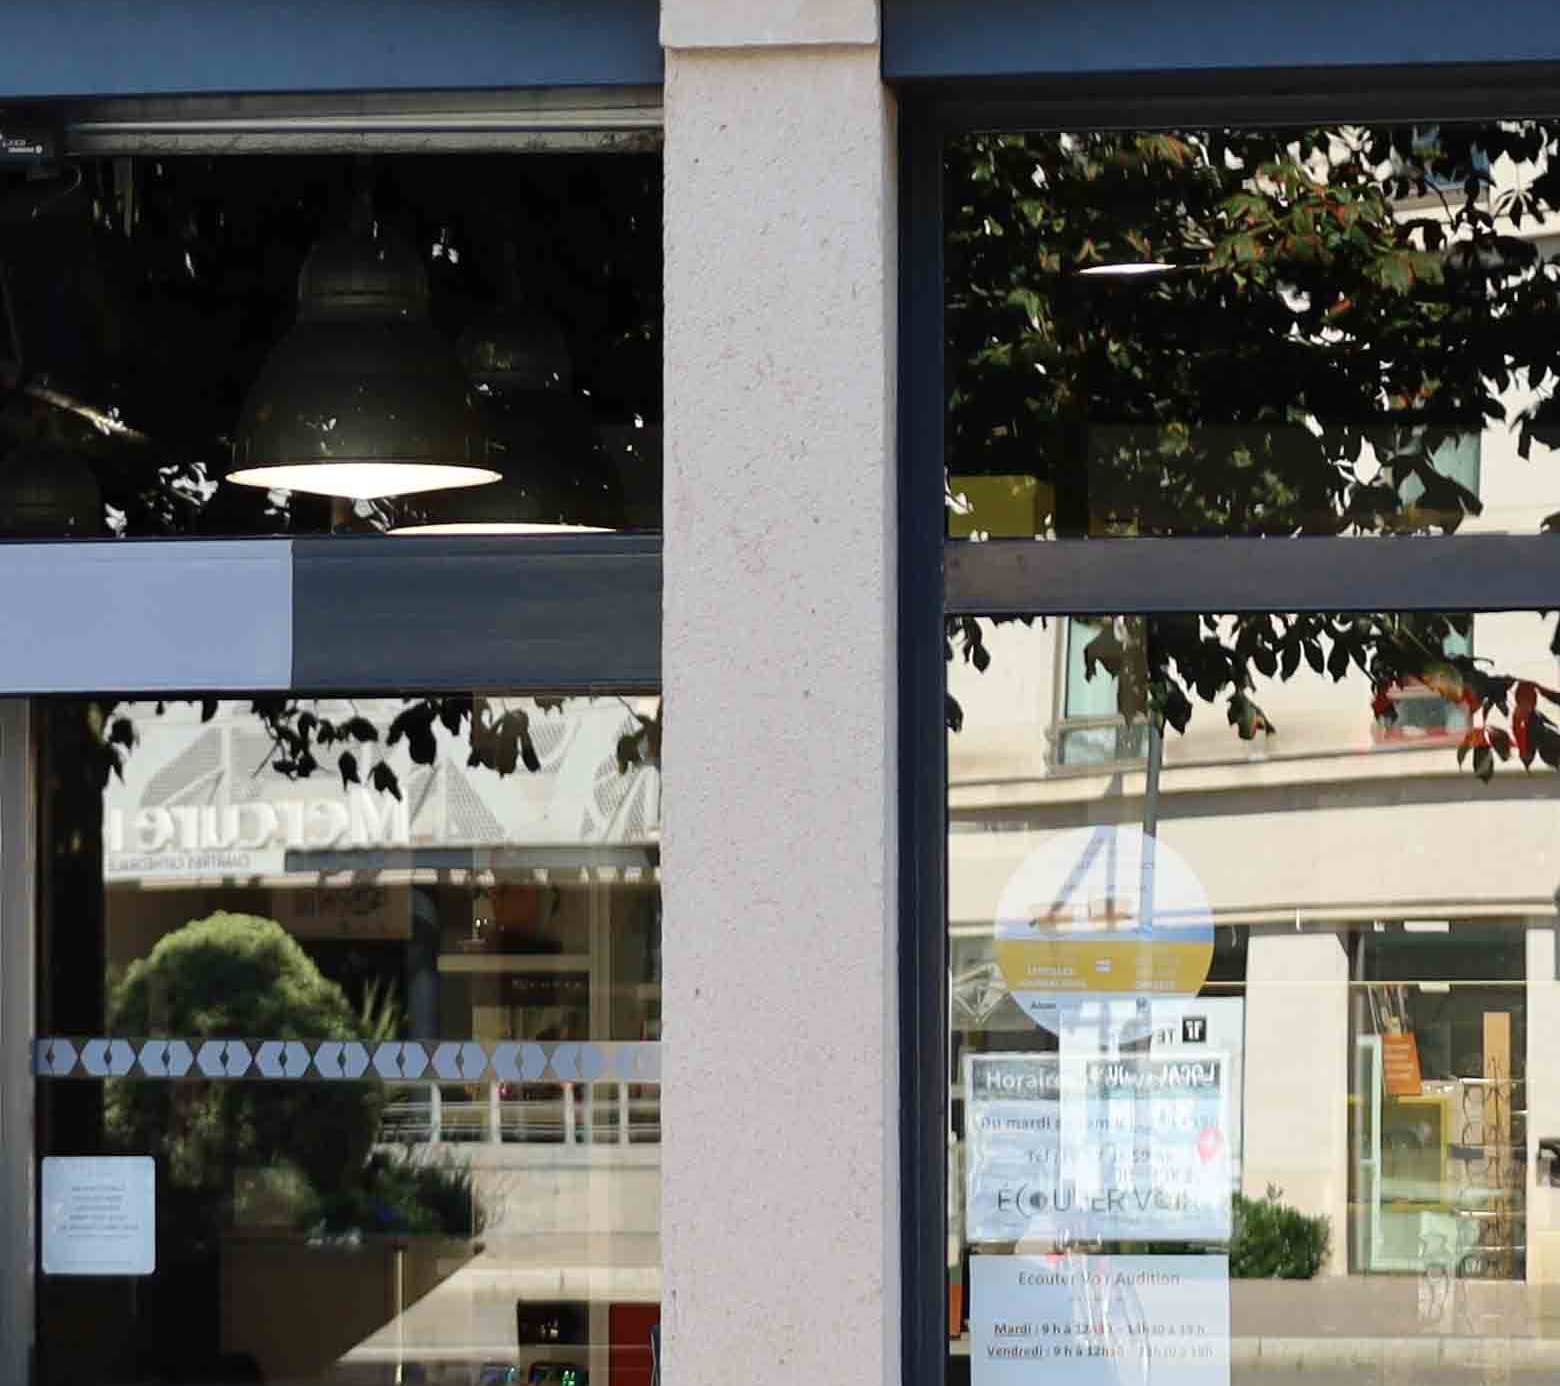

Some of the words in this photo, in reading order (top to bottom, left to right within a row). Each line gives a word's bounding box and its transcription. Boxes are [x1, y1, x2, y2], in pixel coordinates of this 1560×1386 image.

[1006, 1116, 1051, 1130] mardi
[997, 1182, 1126, 1219] ÉCOUER
[1114, 1270, 1181, 1287] Audition
[993, 1323, 1032, 1336] Mardi
[987, 1346, 1043, 1359] Vendredi
